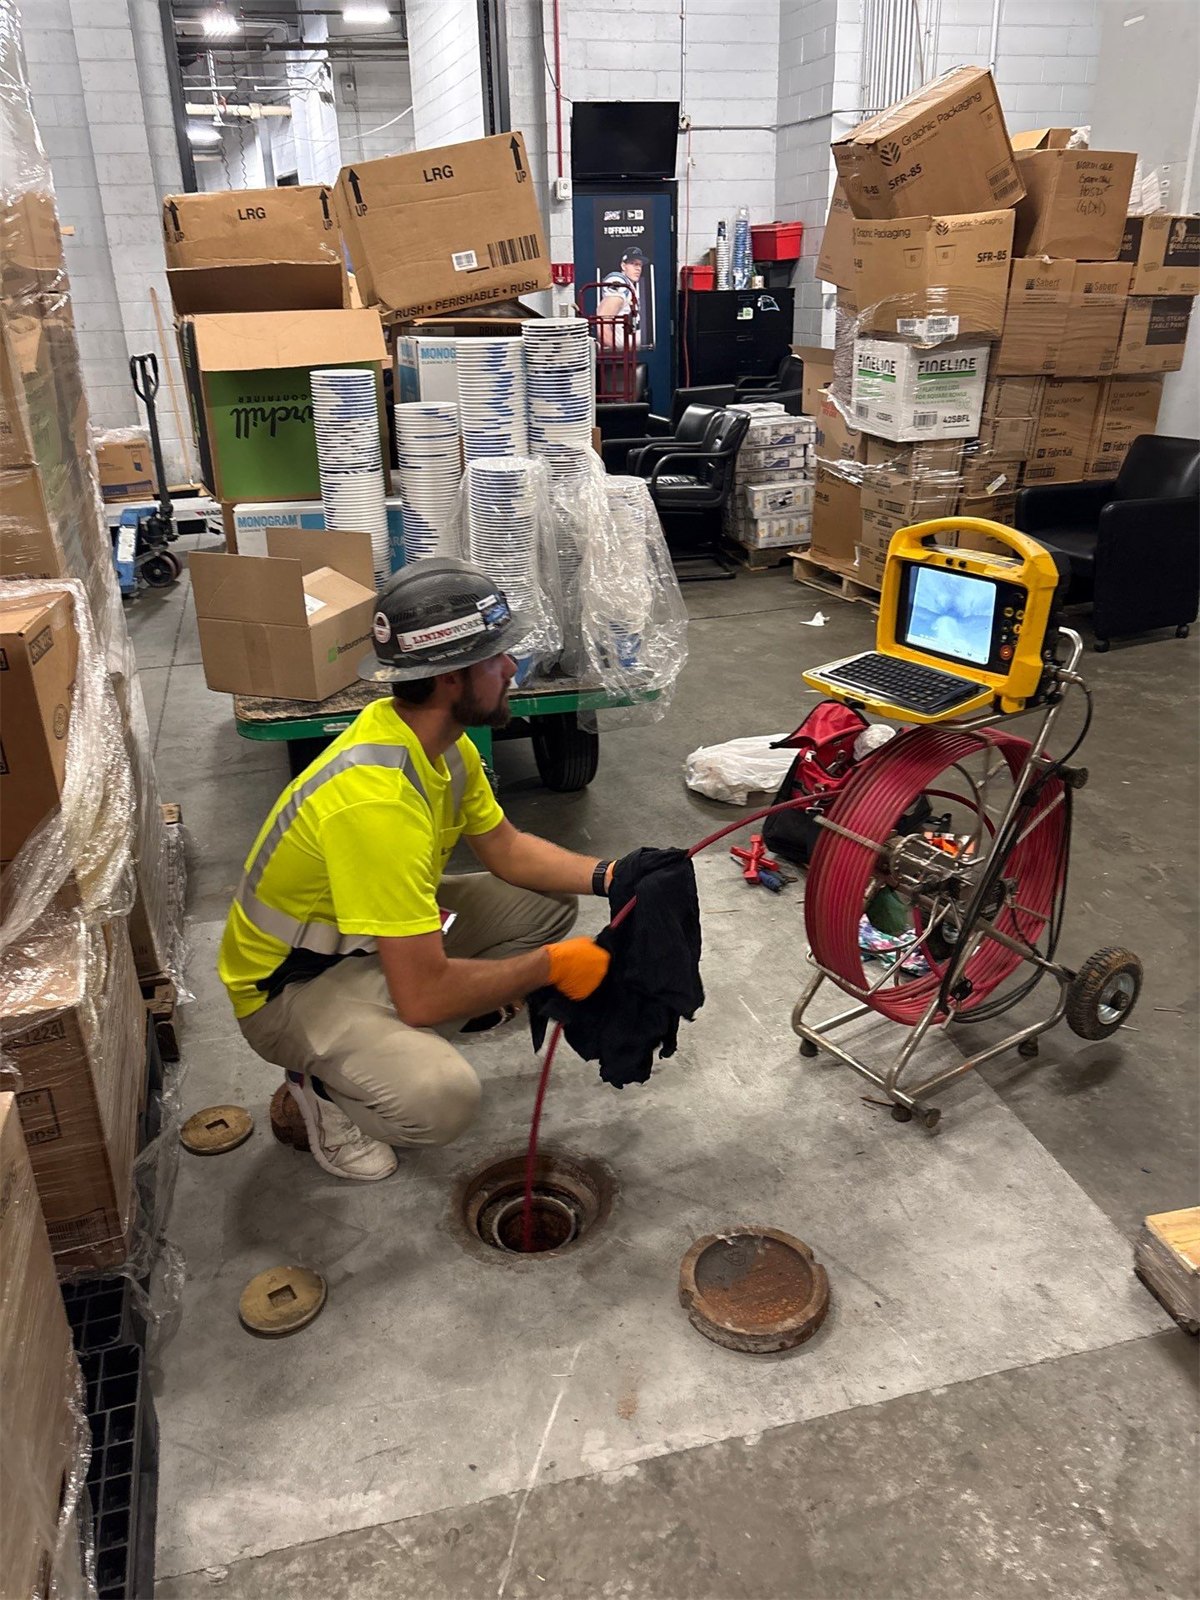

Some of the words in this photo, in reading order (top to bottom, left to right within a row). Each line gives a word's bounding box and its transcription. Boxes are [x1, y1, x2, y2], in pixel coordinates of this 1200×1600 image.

[901, 119, 936, 147] Graphic
[936, 91, 982, 125] Packaging
[423, 165, 454, 183] LRG
[515, 170, 527, 184] UP
[888, 163, 923, 190] SFR-85
[238, 207, 266, 221] LRG
[355, 204, 368, 217] UP
[323, 219, 333, 231] UP
[632, 225, 645, 234] CAP
[175, 231, 185, 243] UP
[874, 227, 911, 240] Packaging
[976, 250, 1007, 263] SFR-85
[1036, 278, 1060, 288] Sabert
[395, 304, 425, 320] RUSH
[435, 288, 500, 310] PERISHABLE
[510, 279, 539, 295] RUSH
[421, 347, 456, 359] MONOG
[918, 358, 977, 372] FINELINE
[238, 394, 308, 403] CONTAINER
[943, 414, 971, 423] 42SBFL
[237, 514, 298, 528] MONOGRAM
